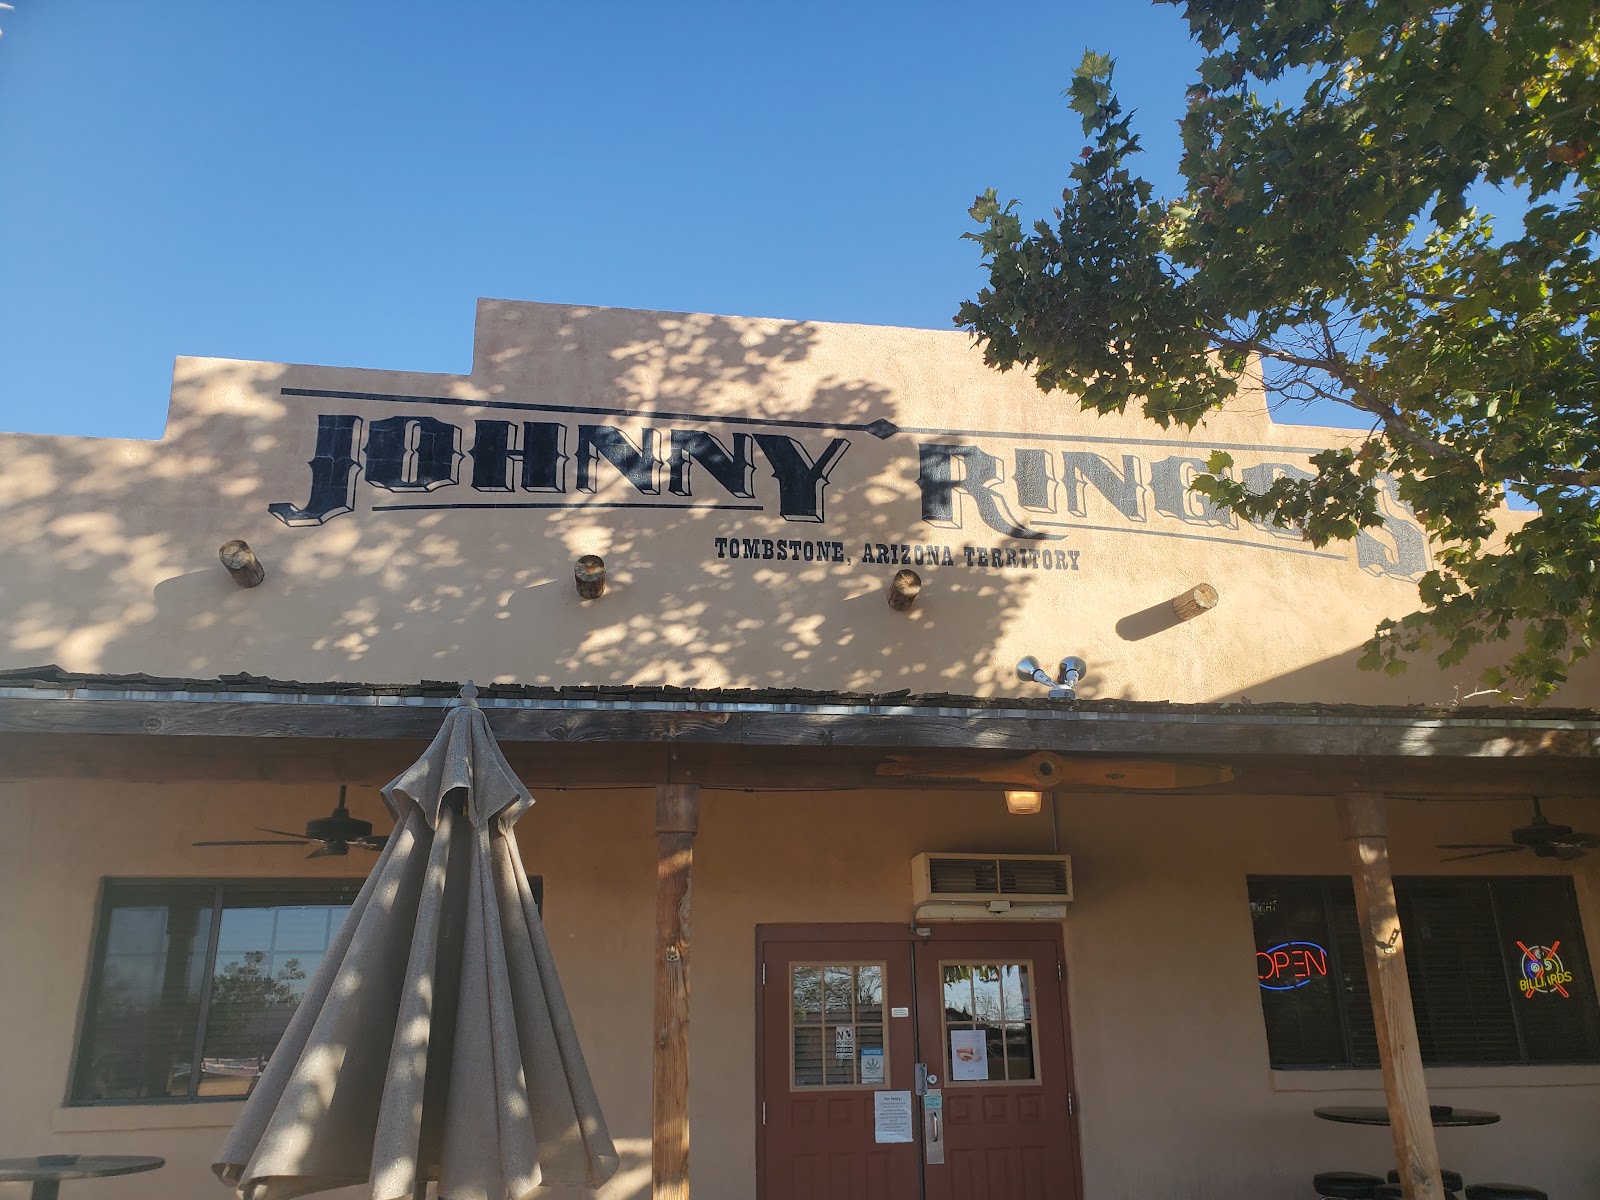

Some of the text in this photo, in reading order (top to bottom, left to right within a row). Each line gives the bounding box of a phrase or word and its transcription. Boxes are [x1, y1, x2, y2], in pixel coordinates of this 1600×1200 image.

[268, 414, 852, 527] JOHNNY
[715, 537, 1081, 571] TOMBSTONE, ARIZONA TERRITORY
[1256, 949, 1327, 979] OPEN
